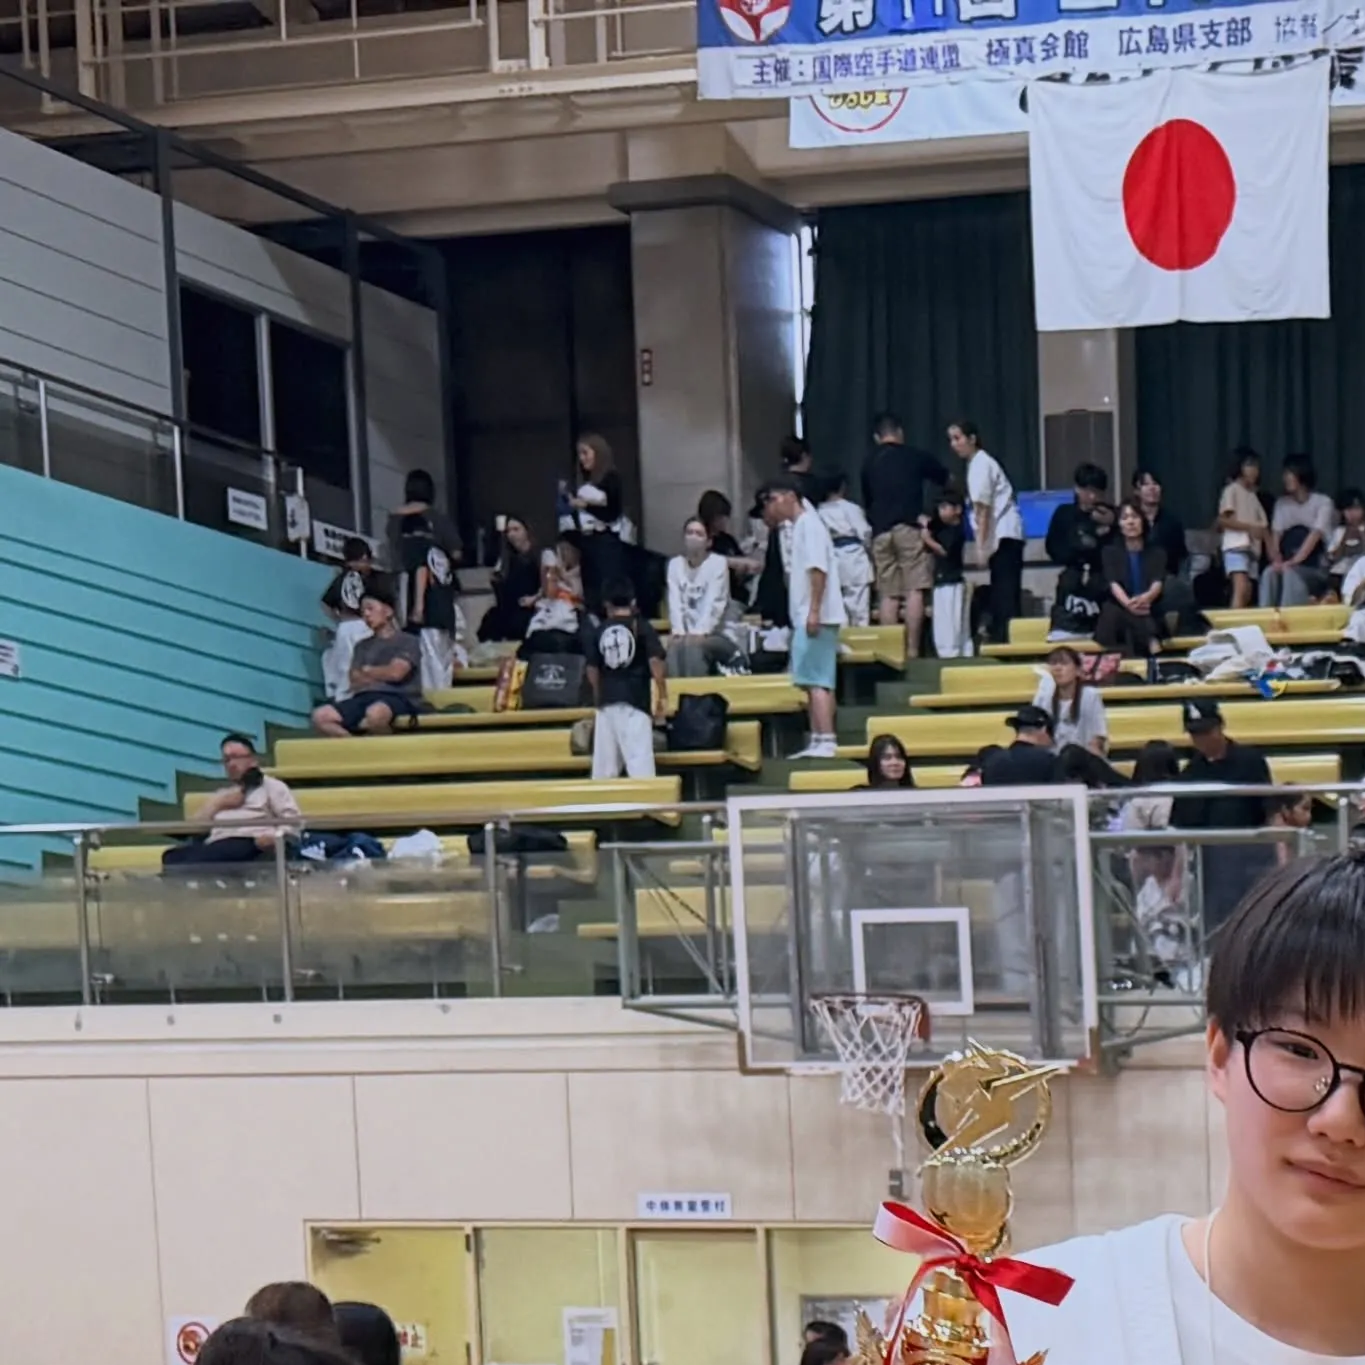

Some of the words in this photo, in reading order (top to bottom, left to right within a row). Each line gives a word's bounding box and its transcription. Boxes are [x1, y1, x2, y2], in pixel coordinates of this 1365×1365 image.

[986, 29, 1089, 66] 極真会館
[1118, 17, 1252, 57] 広島県支部
